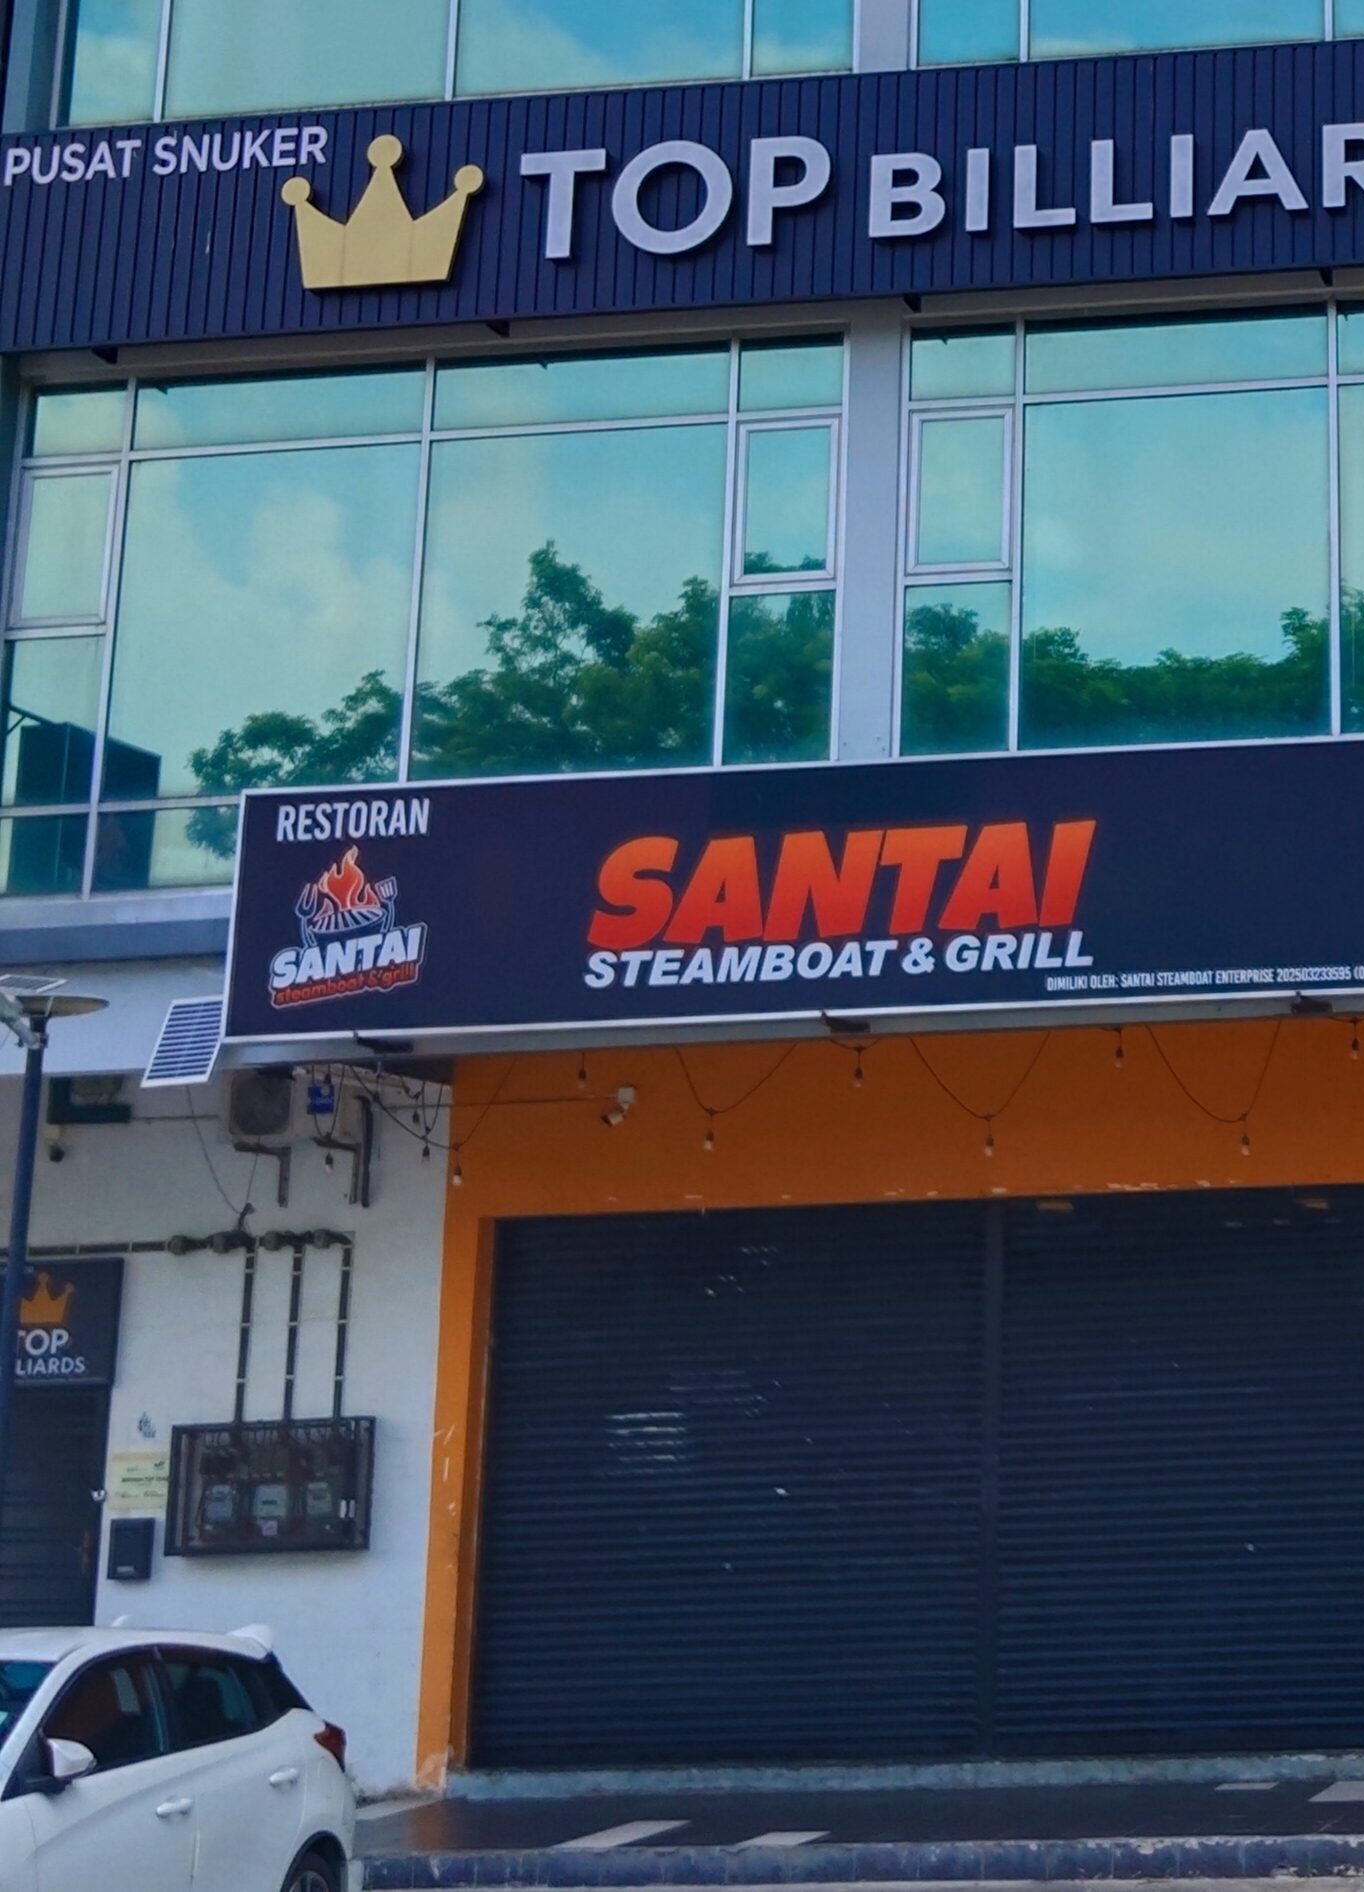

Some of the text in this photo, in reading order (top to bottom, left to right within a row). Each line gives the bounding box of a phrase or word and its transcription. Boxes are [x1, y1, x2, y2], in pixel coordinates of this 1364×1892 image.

[4, 124, 328, 186] PUSAT SNUKER
[518, 134, 832, 262] TOP
[275, 799, 430, 842] RESTORAN
[588, 820, 1097, 950] SANTAI
[273, 927, 421, 988] SANTAI
[276, 975, 365, 1002] steamboat
[383, 962, 415, 987] grill
[584, 930, 1095, 989] STEAMBOAT & GRILL
[1047, 975, 1087, 991] DIMILIKI
[1090, 973, 1118, 989] OLEH:
[1121, 972, 1154, 988] SANTAI
[1157, 970, 1212, 987] STEAMBOAT
[1216, 967, 1275, 984] ENTERPRISE
[16, 1356, 86, 1376] LIARDS
